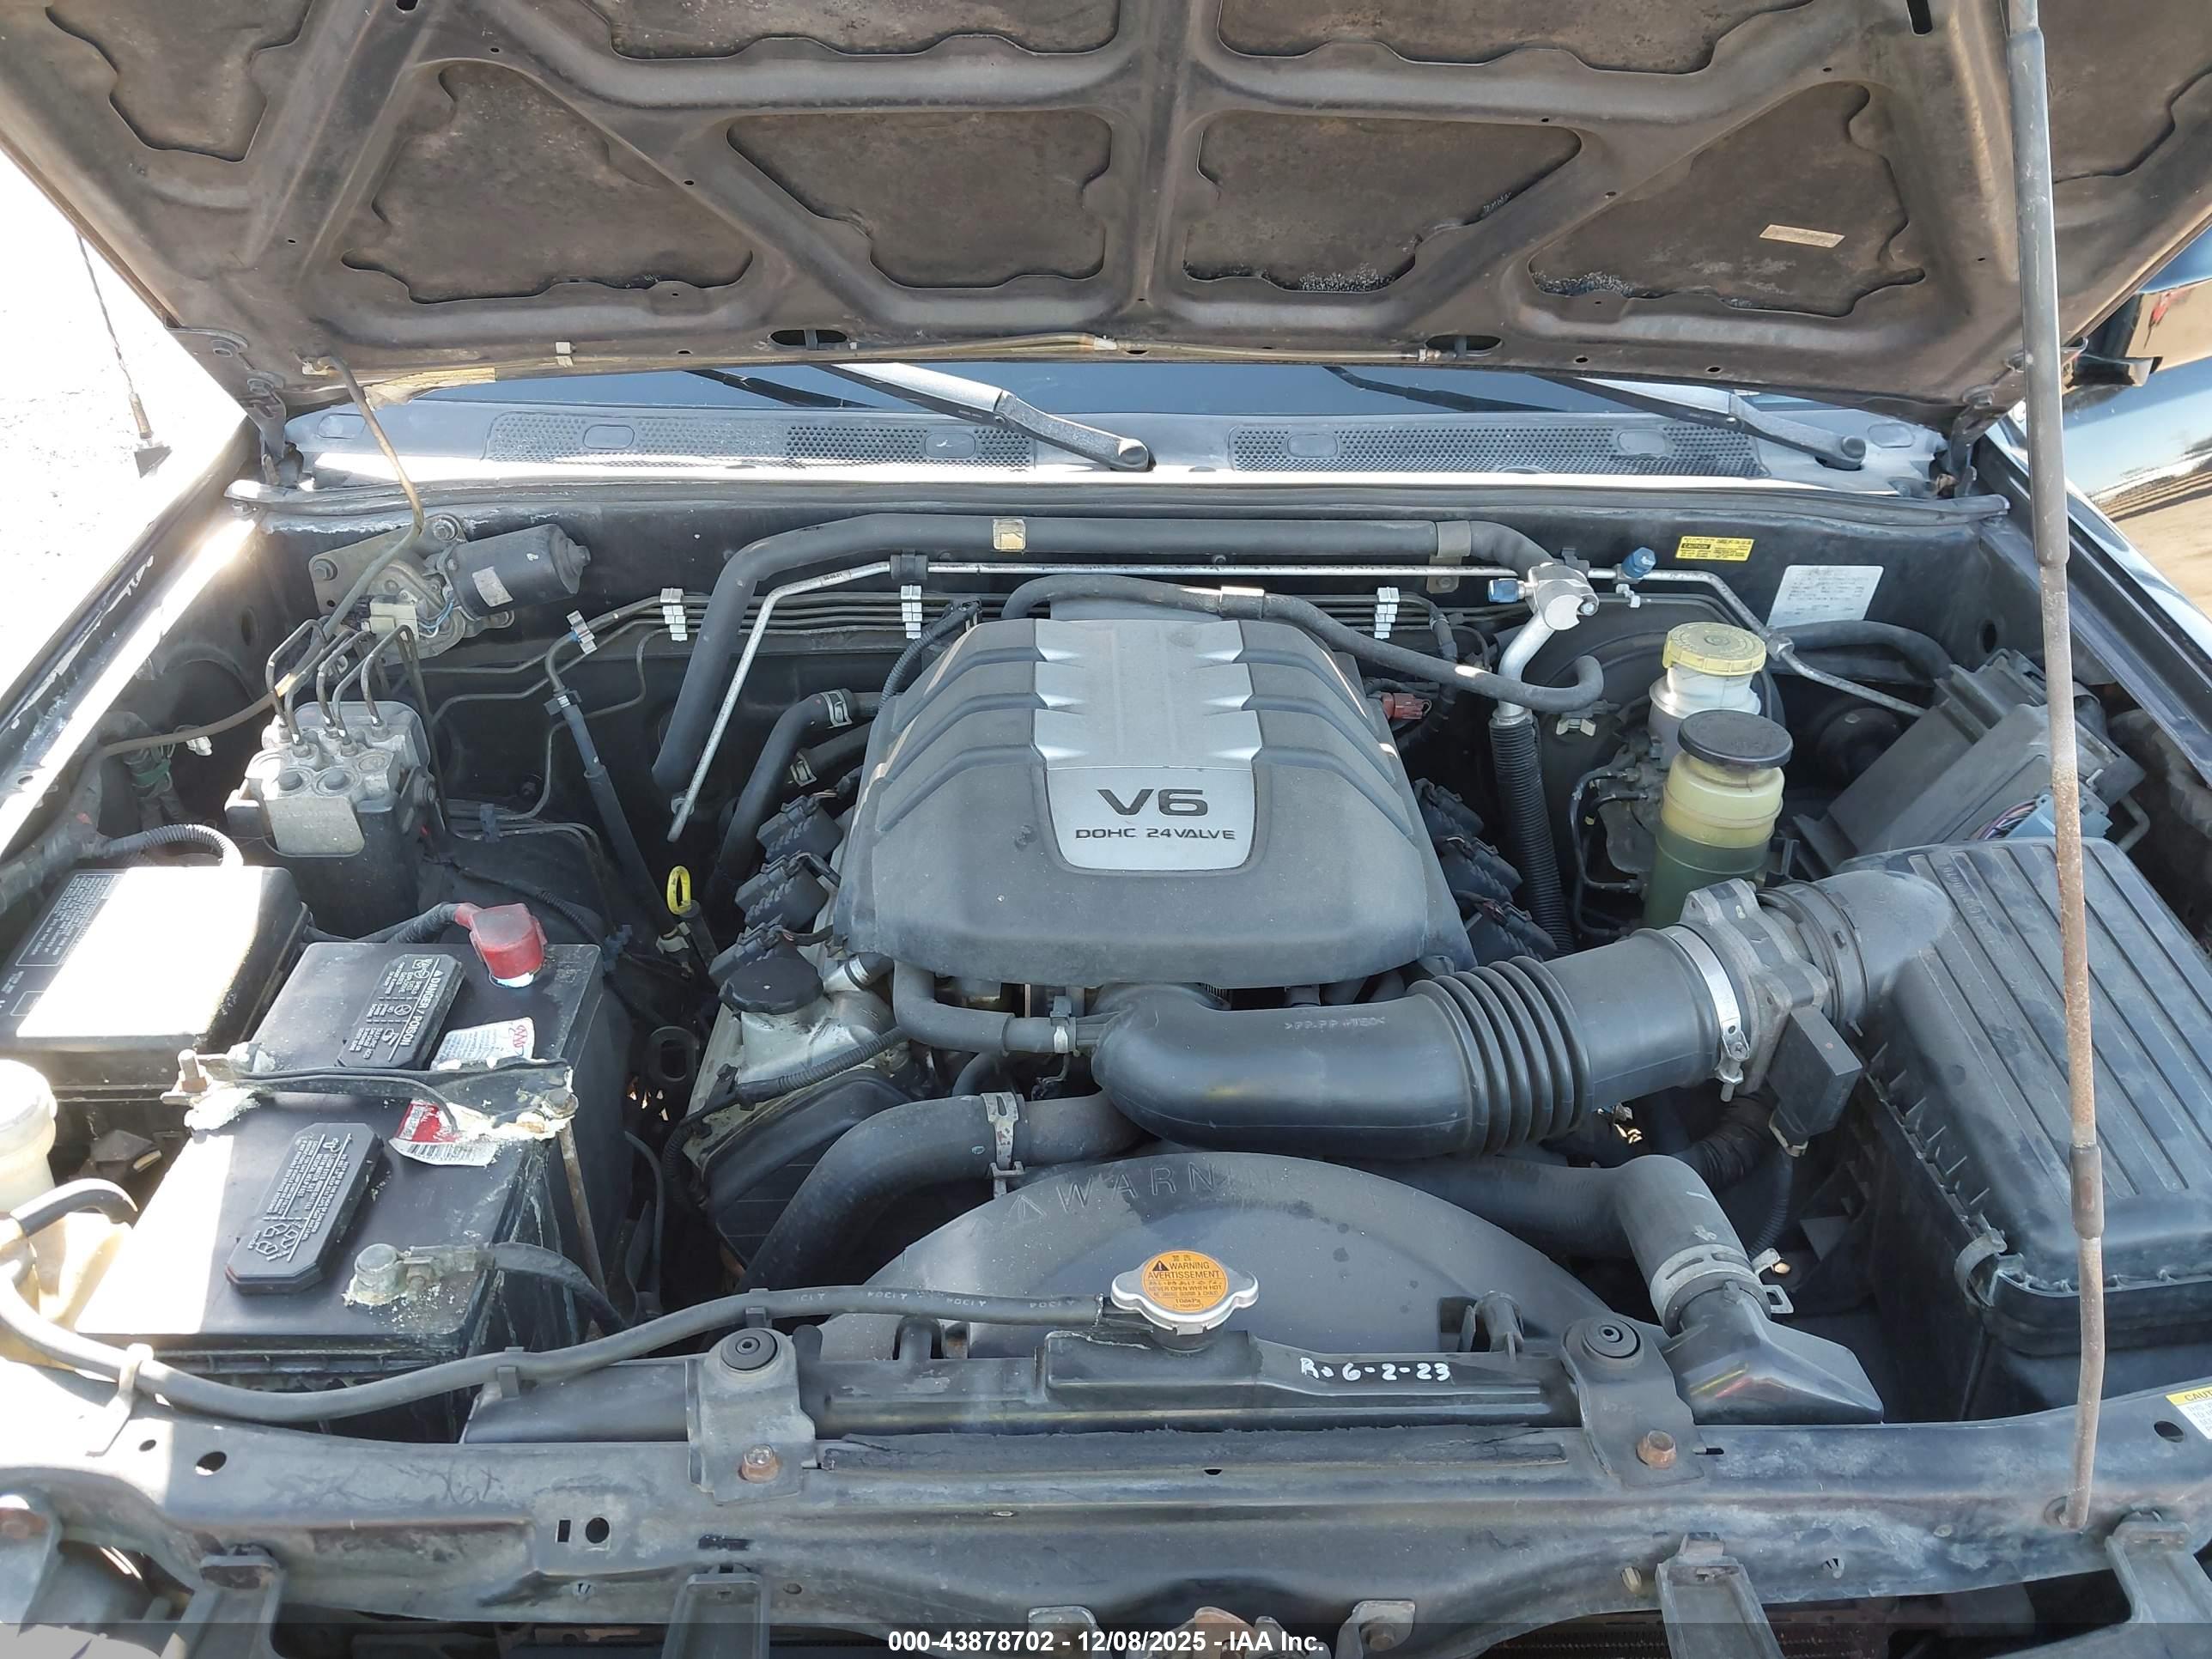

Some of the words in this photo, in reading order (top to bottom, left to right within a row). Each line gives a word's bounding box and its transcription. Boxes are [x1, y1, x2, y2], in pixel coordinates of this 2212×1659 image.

[1097, 788, 1208, 816] V6
[1075, 828, 1136, 839] DOHC
[418, 977, 441, 1009] DANGER
[399, 1015, 423, 1046] POISON
[1147, 1270, 1220, 1279] AVERTISSEMENT
[1169, 1261, 1210, 1270] WARNING
